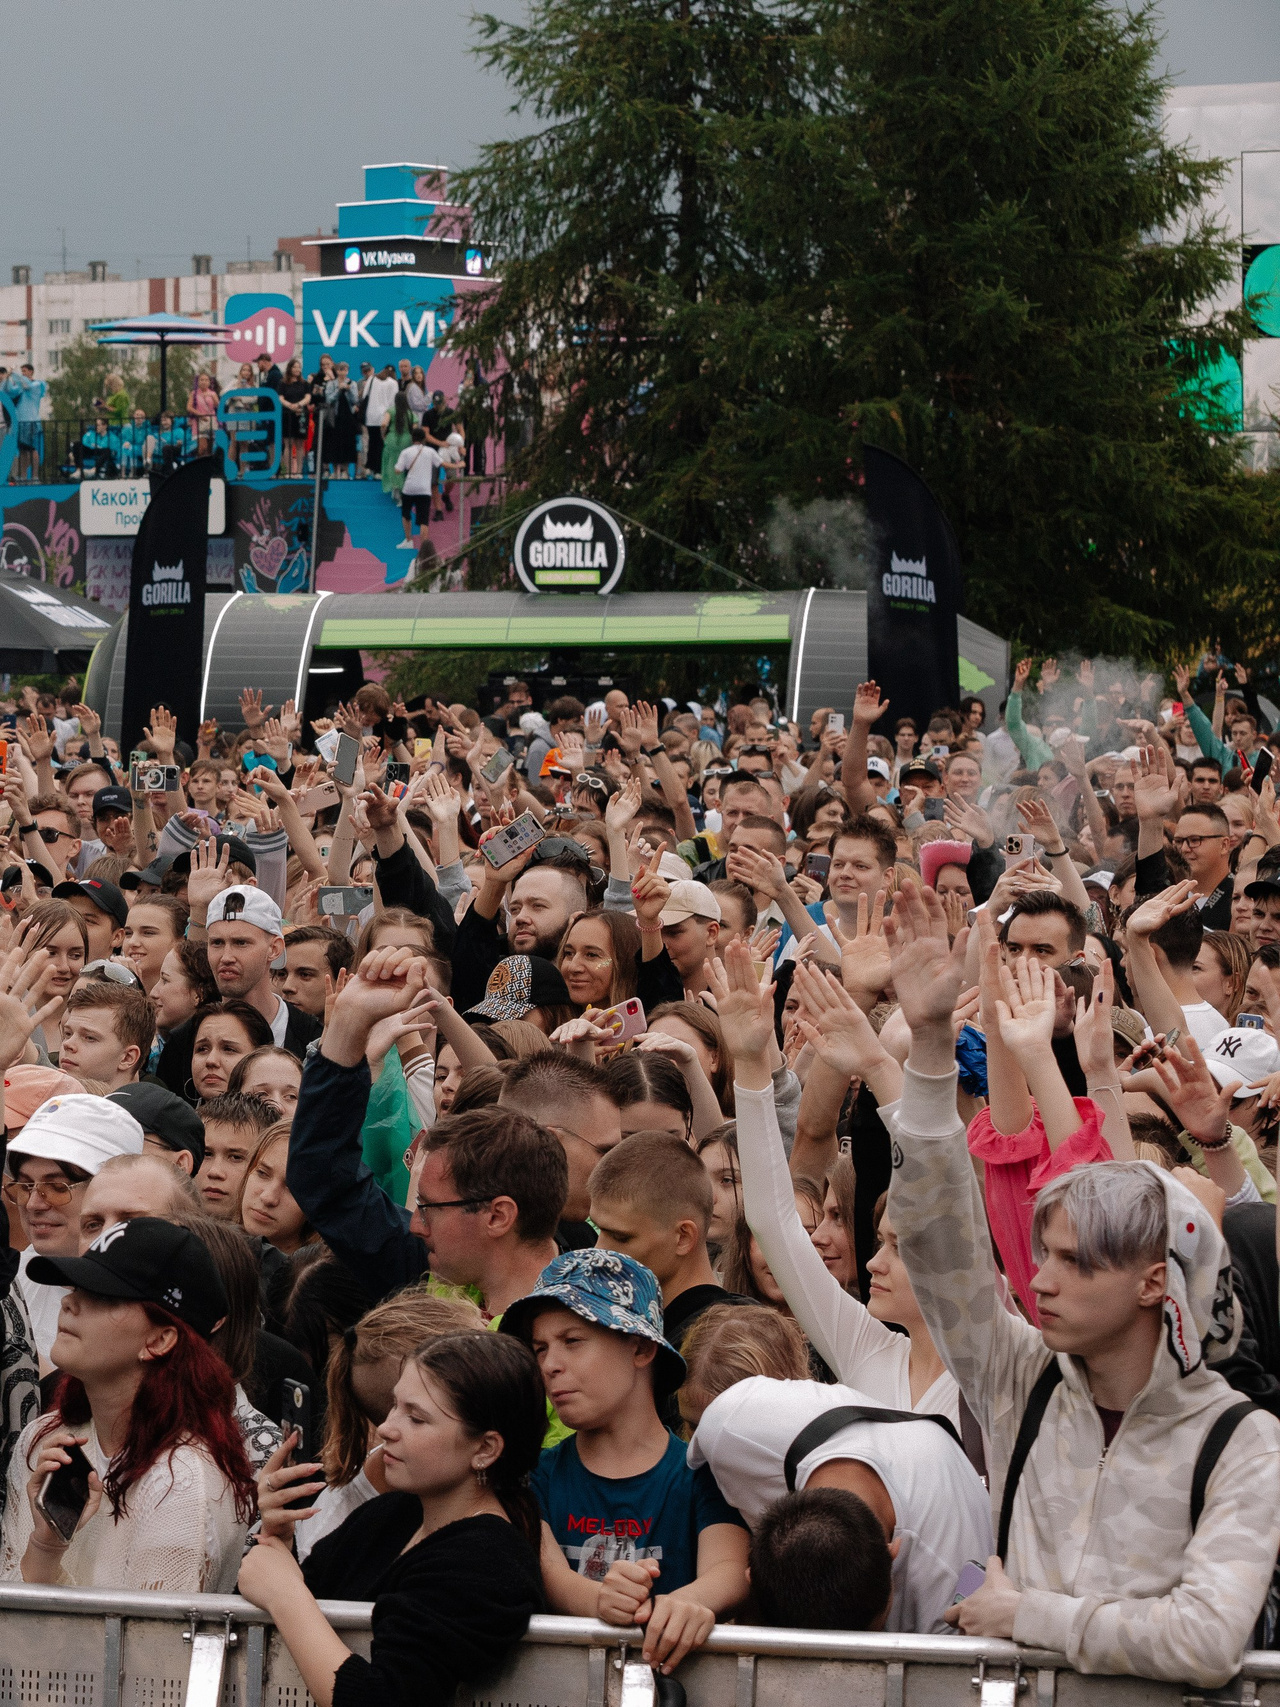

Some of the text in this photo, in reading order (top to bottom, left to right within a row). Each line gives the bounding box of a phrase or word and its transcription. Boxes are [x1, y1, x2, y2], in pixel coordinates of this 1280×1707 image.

[362, 250, 415, 269] VK Музыка
[311, 309, 380, 348] VK
[91, 486, 138, 507] Какой
[529, 541, 608, 568] GORILLA
[141, 581, 191, 606] GORILLA
[882, 572, 936, 604] GORILLA
[1216, 1035, 1242, 1058] NY
[567, 1513, 653, 1537] MELODY
